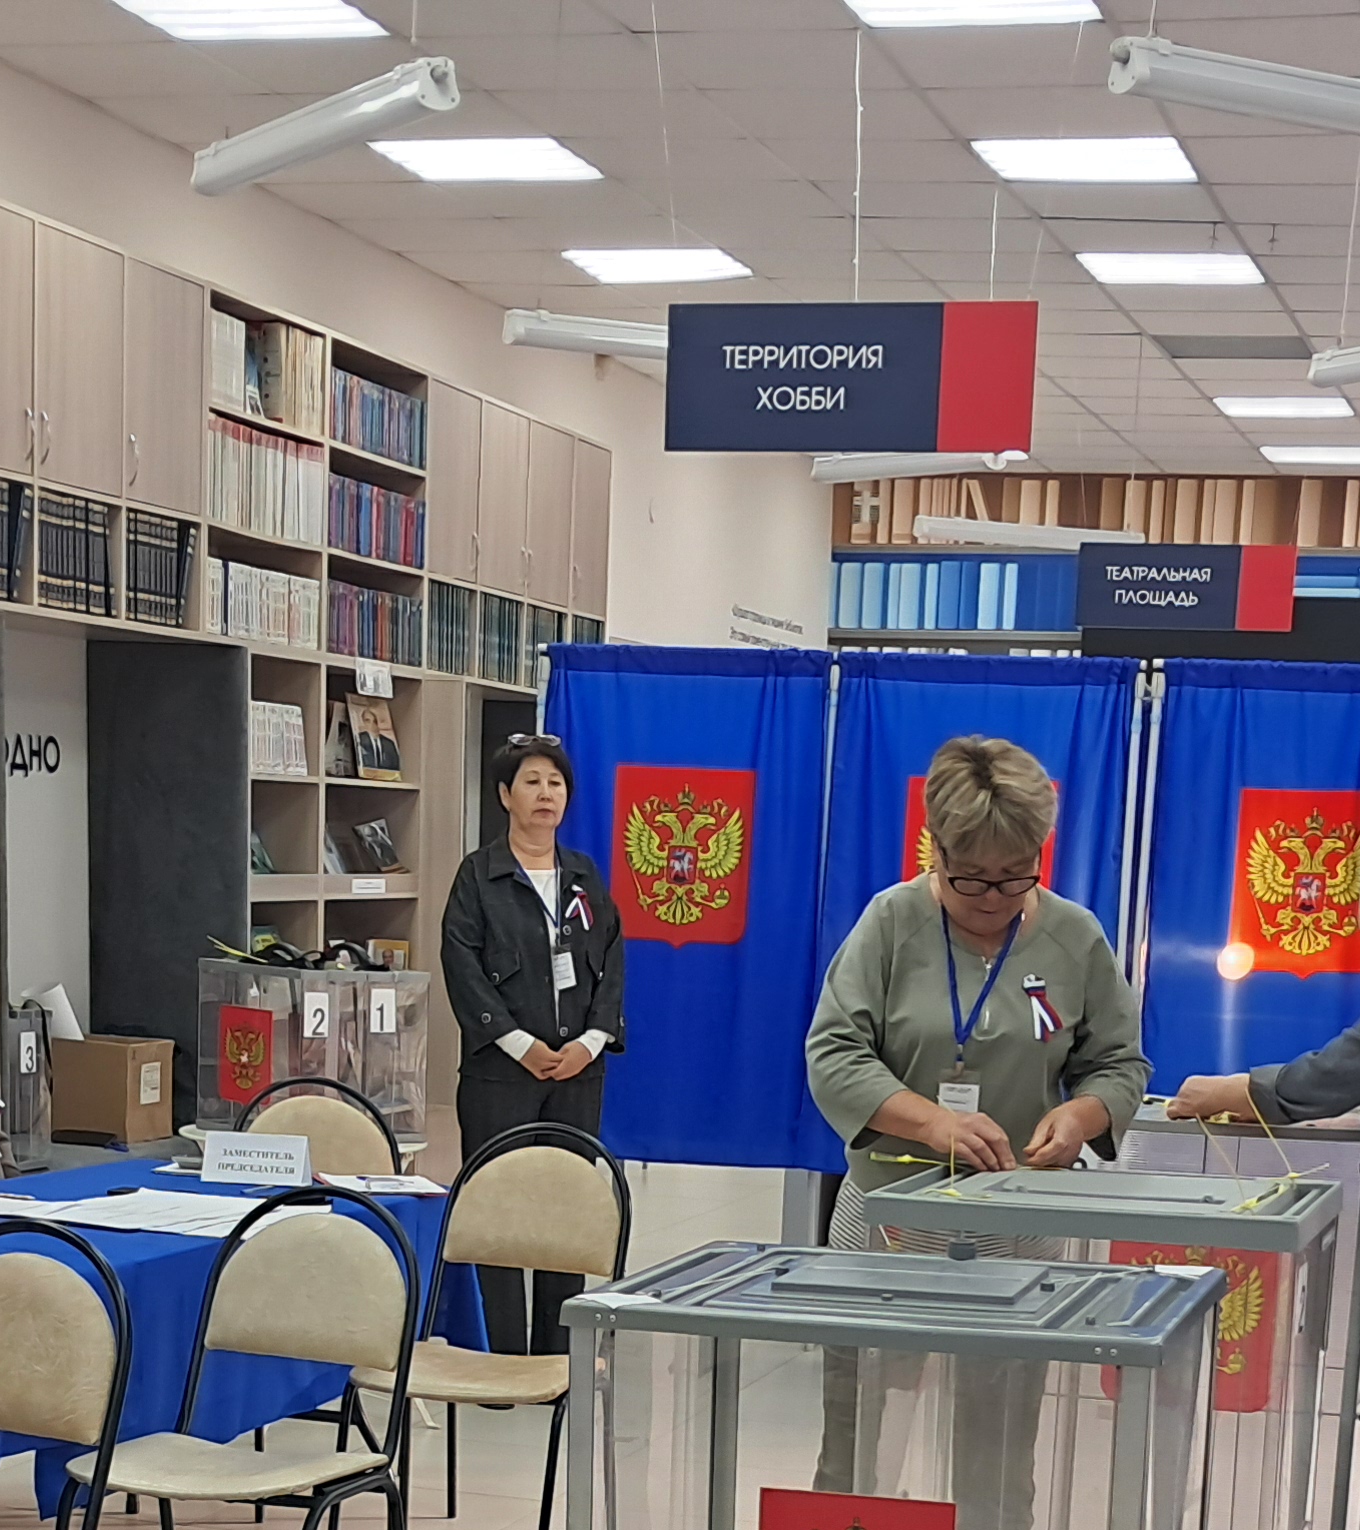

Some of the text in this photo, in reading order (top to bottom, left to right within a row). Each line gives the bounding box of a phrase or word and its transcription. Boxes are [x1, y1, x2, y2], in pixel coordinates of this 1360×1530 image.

[721, 345, 884, 370] ТЕРРИТОРИЯ
[755, 386, 846, 411] ХОББИ
[1105, 566, 1212, 583] ТЕАТРАЛЬНАЯ
[1114, 589, 1199, 607] ПЛОЩАДЬ
[311, 1007, 326, 1036] 2
[375, 1003, 384, 1032] 1
[25, 1045, 35, 1072] 3
[222, 1148, 295, 1160] ЗАМЕСТИТЕЛЬ
[217, 1162, 295, 1175] ПРЕДСЕДАТЕЛЯ
